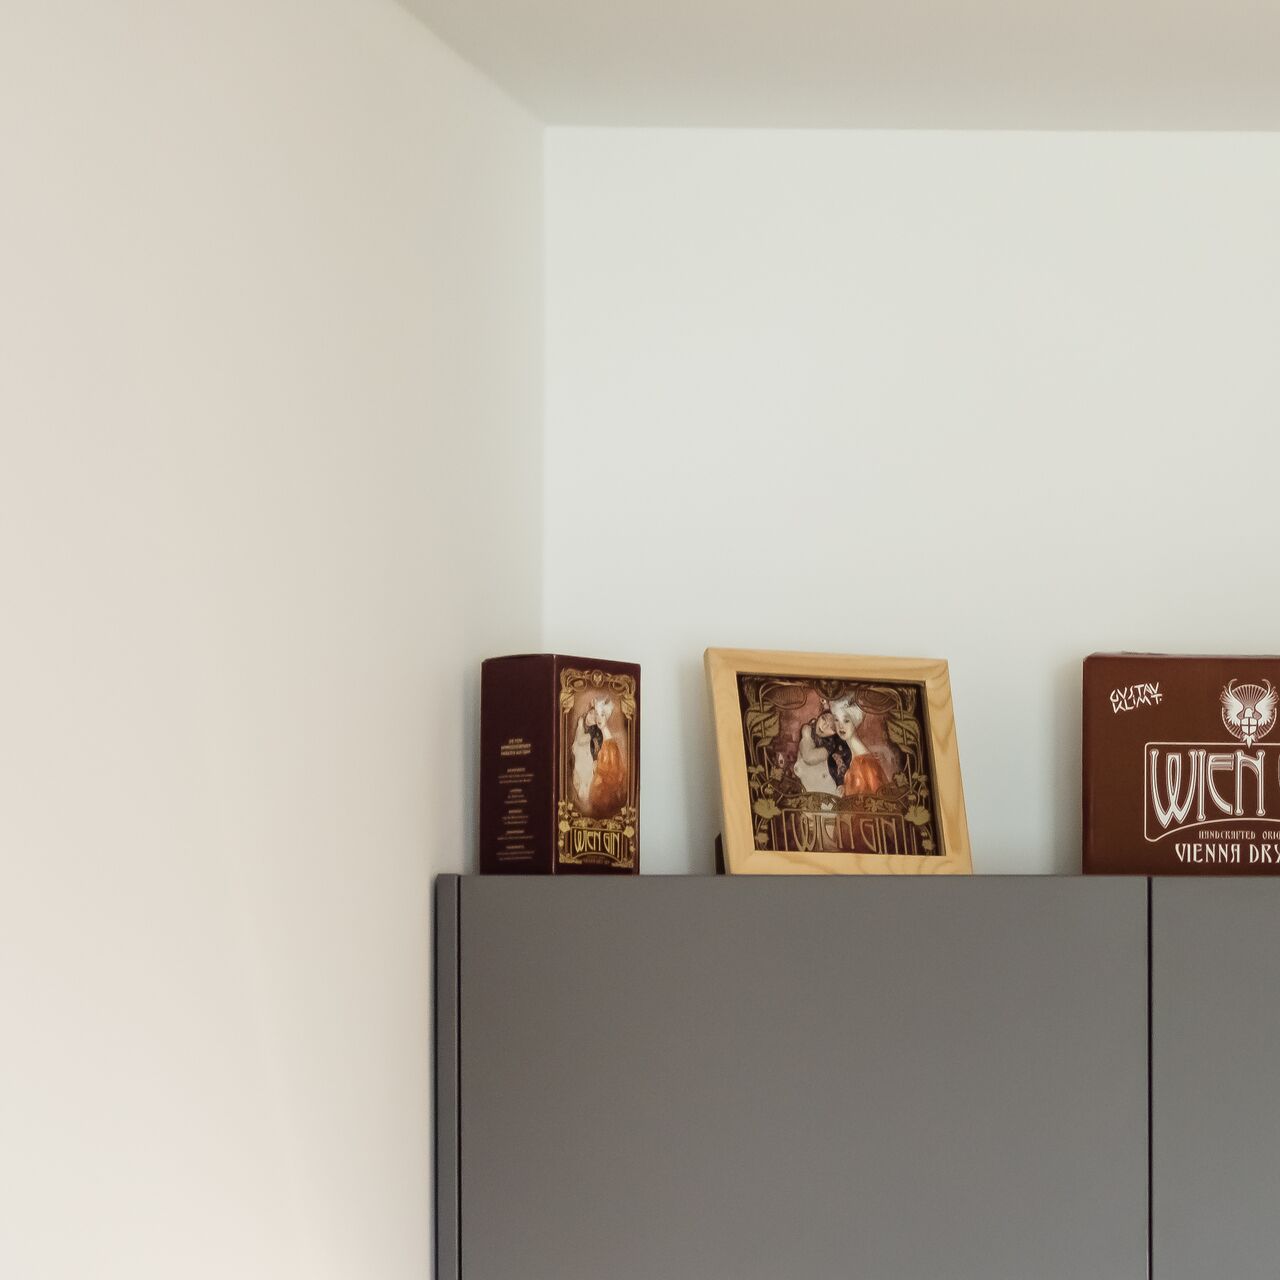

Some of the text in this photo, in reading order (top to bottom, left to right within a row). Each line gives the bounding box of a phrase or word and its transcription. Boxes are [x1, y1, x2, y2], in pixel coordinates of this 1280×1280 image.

[1149, 749, 1266, 829] WIEN
[573, 829, 620, 859] WIEN GIN
[793, 811, 900, 856] WIEN GIN
[1174, 843, 1241, 863] VIENNA
